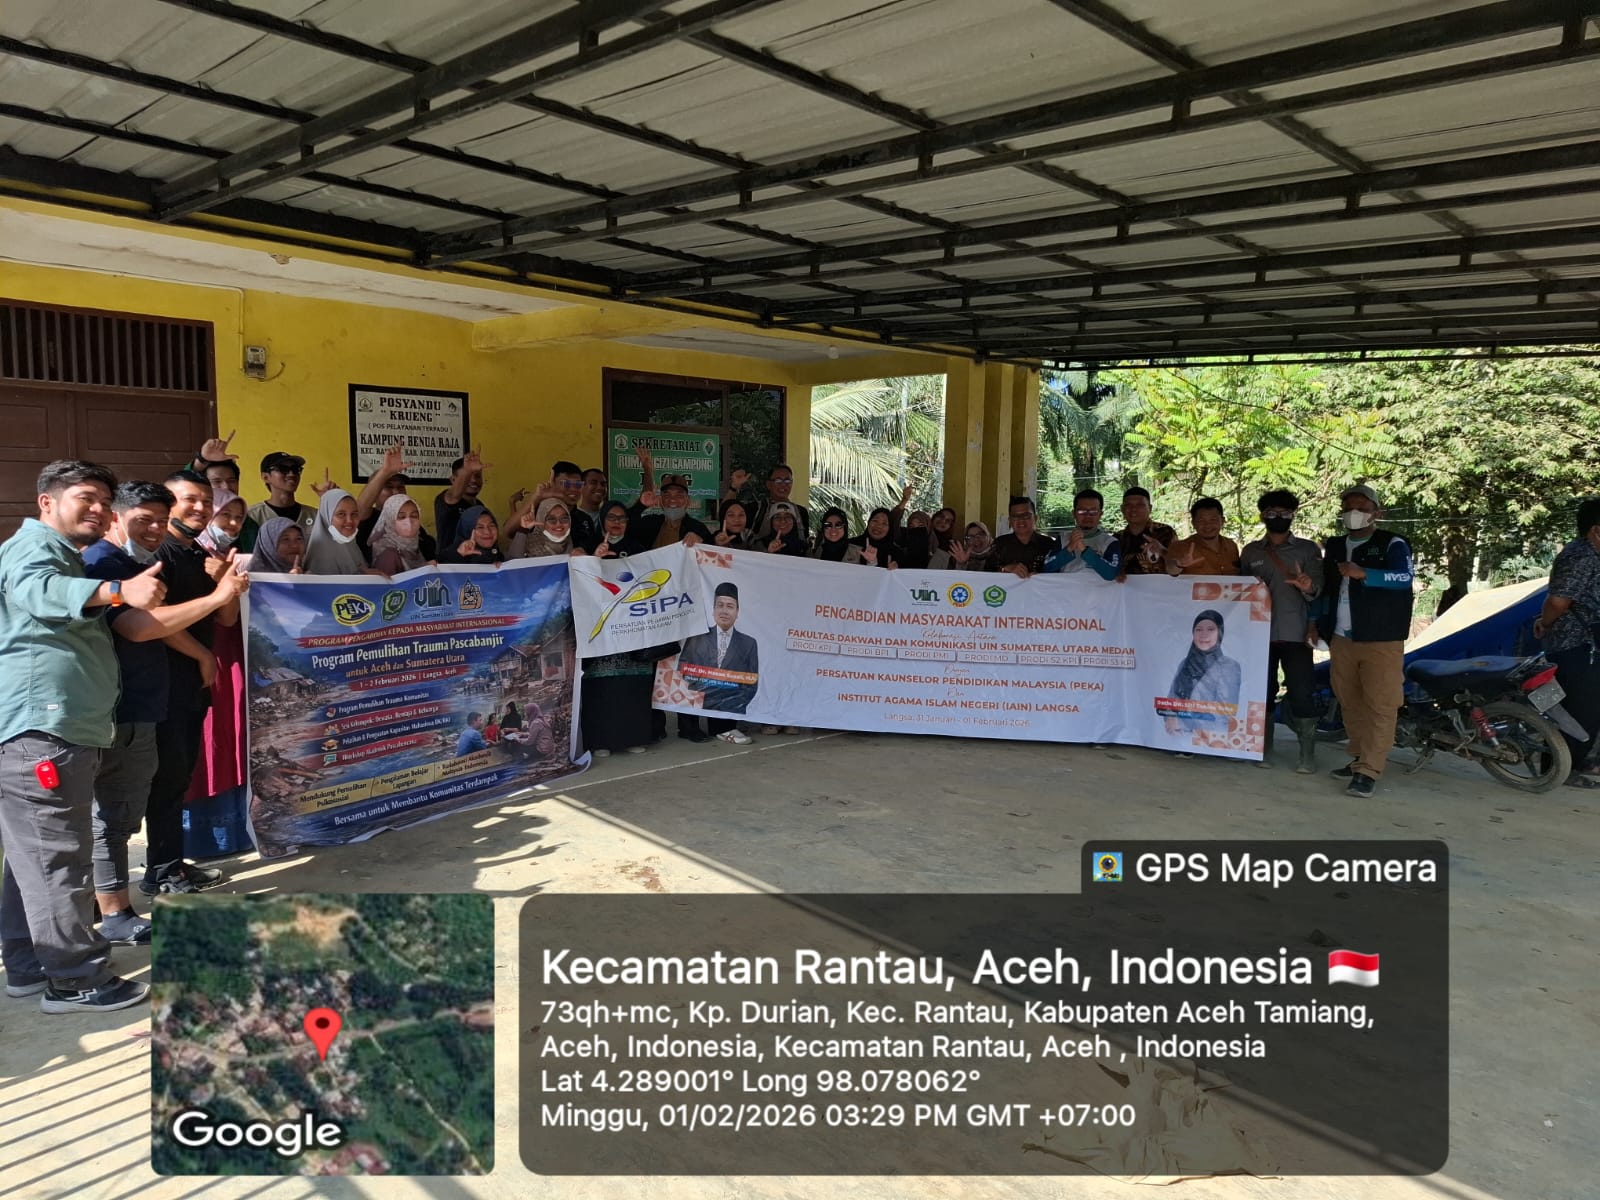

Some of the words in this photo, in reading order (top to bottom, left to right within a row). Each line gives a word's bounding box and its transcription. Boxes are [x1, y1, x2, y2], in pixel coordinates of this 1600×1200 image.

[380, 397, 440, 410] POSYANDU
[390, 411, 432, 422] KRUENG
[360, 434, 404, 446] KAMPUNG
[408, 436, 436, 447] BENUA
[439, 438, 460, 448] RAJA
[632, 438, 700, 452] SEKRETARIAT
[336, 602, 371, 616] PEKA
[815, 604, 896, 624] PENGABDIAN
[900, 613, 990, 628] MASYARAKAT
[995, 616, 1106, 631] INTERNASIONAL
[308, 638, 347, 646] PROGRAM
[388, 627, 414, 636] KEPADA
[788, 628, 835, 641] FAKULTAS
[838, 634, 882, 645] DAKWAH
[910, 640, 976, 649] KOMUNIKASI
[1001, 644, 1058, 653] SUMATERA
[1063, 645, 1099, 654] UTARA
[1101, 646, 1135, 655] MEDAN
[312, 653, 354, 669] Program
[357, 644, 410, 661] Pemulihan
[413, 641, 448, 654] Trauma
[450, 634, 504, 649] Pascabanjir
[965, 653, 993, 661] PRODI
[346, 666, 368, 677] untuk
[371, 661, 391, 672] Aceh
[406, 656, 444, 668] Sumatera
[446, 654, 465, 662] Utara
[375, 678, 399, 686] Februari
[402, 674, 416, 682] 2026
[816, 668, 875, 680] PERSATUAN
[878, 673, 939, 684] KAUNSELOR
[942, 677, 1008, 687] PENDIDIKAN
[1012, 680, 1066, 689] MALAYSIA
[1070, 681, 1104, 692] (PEKA)
[838, 693, 881, 703] INSTITUT
[884, 696, 922, 706] AGAMA
[926, 699, 957, 708] ISLAM
[961, 701, 999, 710] NEGERI
[1002, 702, 1032, 712] (IAIN)
[1036, 704, 1079, 713] LANGSA
[973, 717, 1007, 726] Februari
[1010, 719, 1030, 727] 2026
[411, 768, 429, 777] Belajar
[335, 812, 366, 825] Bersama
[369, 802, 390, 816] untuk
[392, 795, 428, 809] Membantu
[429, 785, 464, 798] Komunitas
[464, 773, 498, 788] Terdampak
